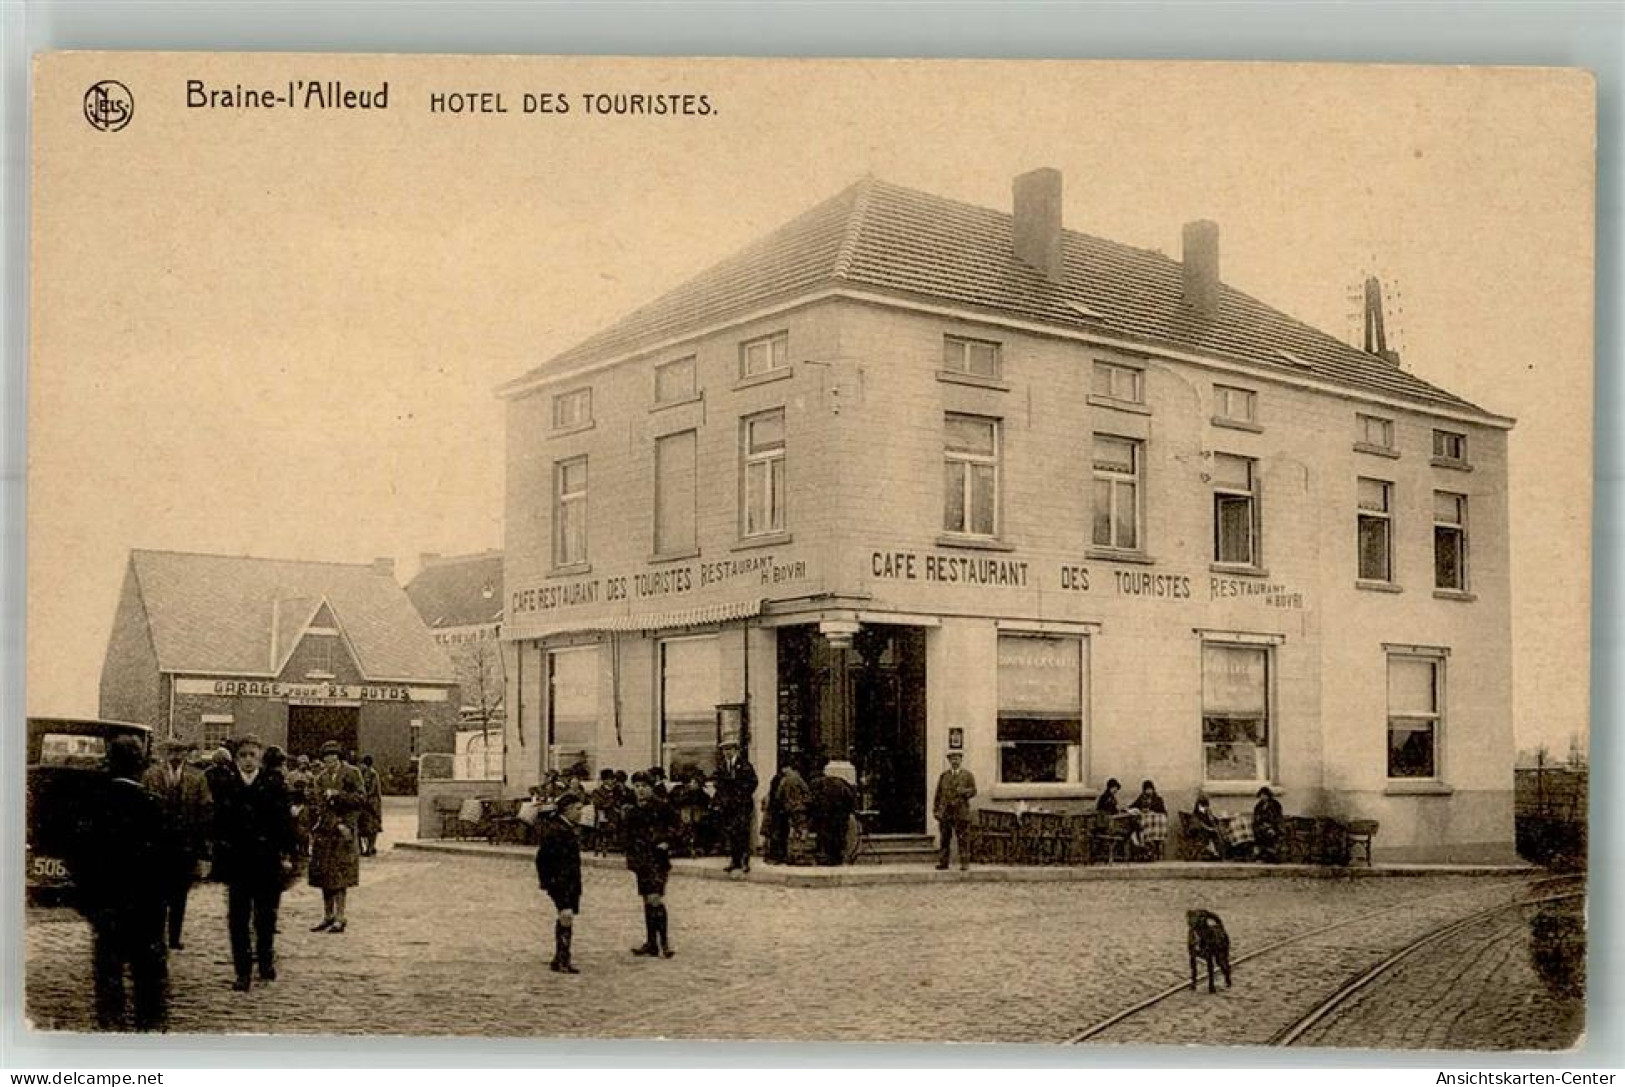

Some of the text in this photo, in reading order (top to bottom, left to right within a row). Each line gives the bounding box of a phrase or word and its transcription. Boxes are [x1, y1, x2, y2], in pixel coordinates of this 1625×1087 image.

[701, 556, 773, 586] RESTAURANT
[872, 552, 1190, 598] CAFE RESTAURANT DES TOURISTES
[513, 567, 690, 613] CAFE RESTAURANT DES TOURISTES
[1210, 577, 1286, 602] RESTAURANT
[214, 681, 281, 696] GARAGE
[361, 686, 408, 701] AUTOS
